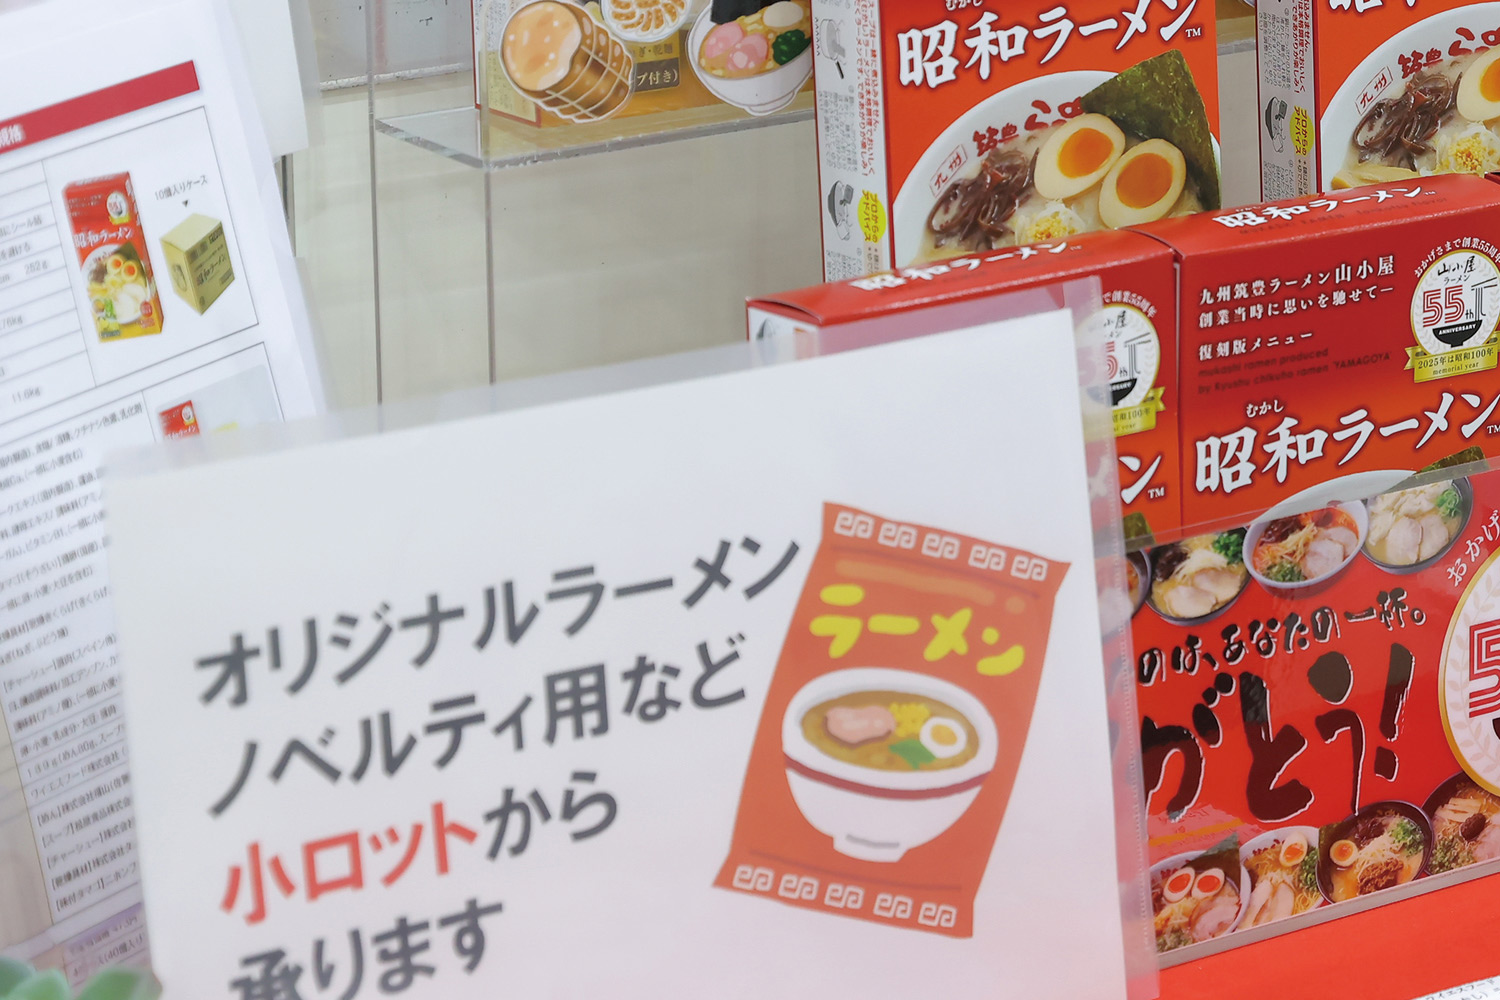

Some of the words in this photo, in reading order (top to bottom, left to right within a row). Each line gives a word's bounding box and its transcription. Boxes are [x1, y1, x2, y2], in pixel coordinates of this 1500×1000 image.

[1200, 255, 1395, 306] 九州筑豊ラーメン山小屋
[1199, 331, 1313, 360] 復刻版メニュー
[1418, 348, 1494, 370] 2025年は昭和100年
[1439, 323, 1476, 335] ANNIVERSARY
[1195, 392, 1500, 494] 昭和ラーメン
[1246, 399, 1284, 417] むかし
[194, 532, 801, 712] オリジナルラーメン
[809, 584, 1026, 677] ラーメン
[206, 629, 748, 820] ノベルティ用など
[219, 767, 620, 927] 小ロットから
[228, 896, 506, 1000] 承ります
